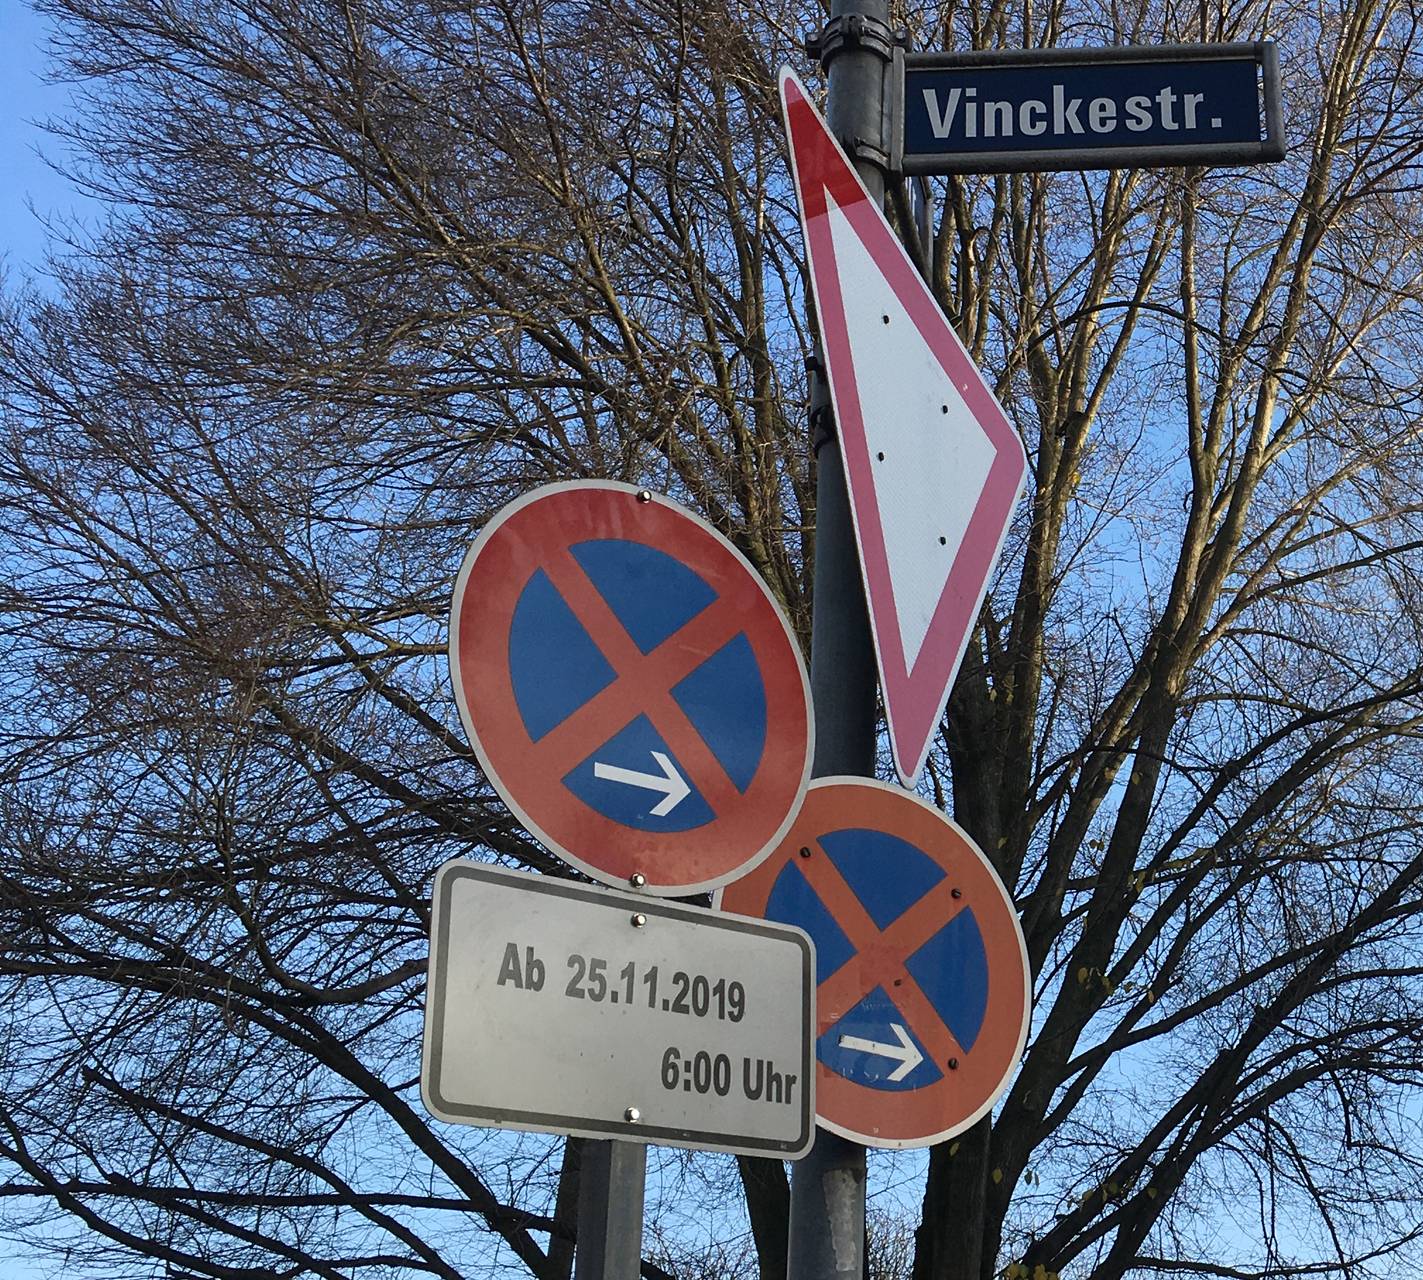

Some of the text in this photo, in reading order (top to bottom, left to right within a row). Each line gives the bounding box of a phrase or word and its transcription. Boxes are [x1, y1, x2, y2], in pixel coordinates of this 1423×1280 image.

[922, 84, 1222, 138] Vinckestr.
[497, 942, 746, 1023] Ab 25.11.2019
[661, 1046, 798, 1105] 6:00 Uhr
